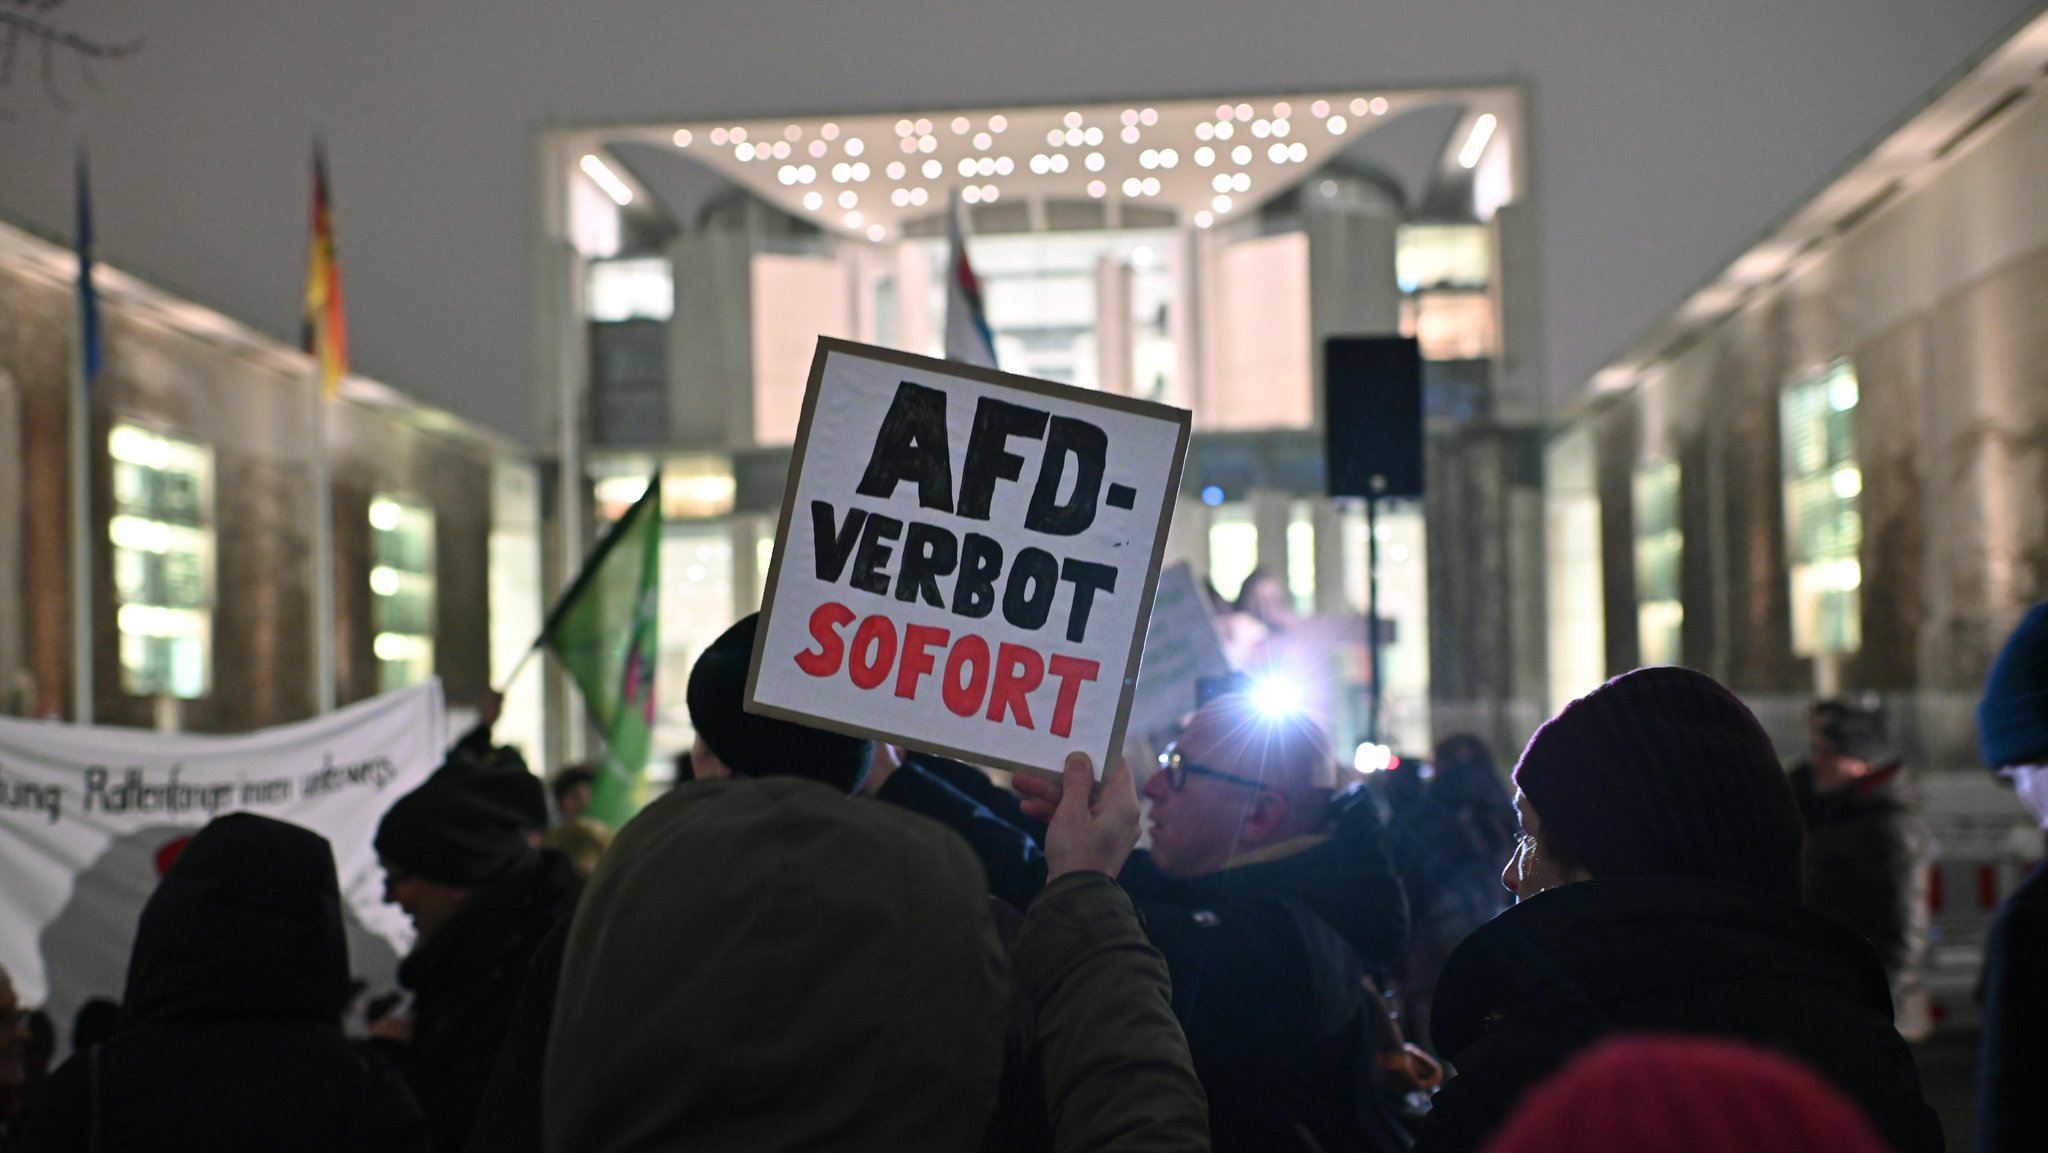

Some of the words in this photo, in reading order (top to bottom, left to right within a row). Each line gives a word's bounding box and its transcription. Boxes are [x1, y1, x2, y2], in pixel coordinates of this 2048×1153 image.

[855, 381, 1137, 537] AFD-
[811, 500, 1119, 644] VERBOT
[794, 602, 1101, 738] SOFORT
